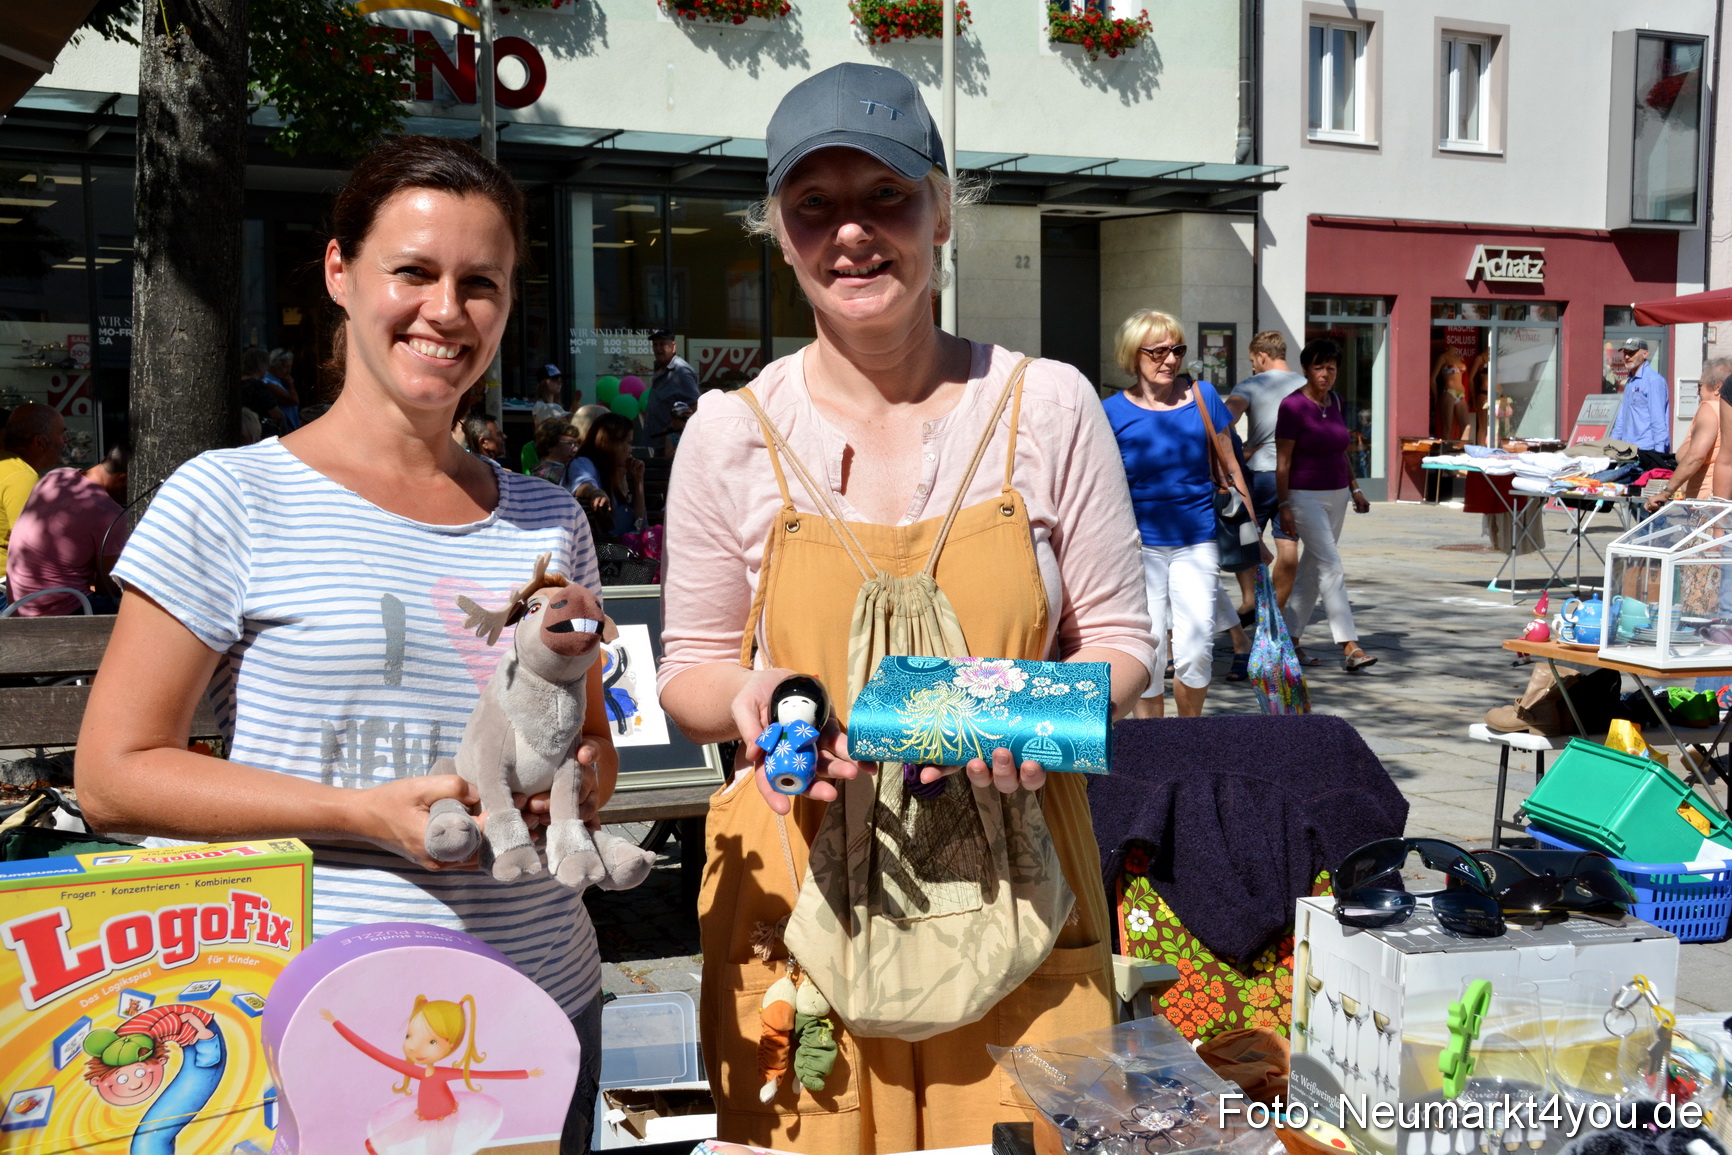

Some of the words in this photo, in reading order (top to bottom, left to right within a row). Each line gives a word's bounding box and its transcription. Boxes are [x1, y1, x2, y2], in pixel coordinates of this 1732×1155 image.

[1015, 254, 1031, 269] 22
[1465, 244, 1545, 282] Achatz
[99, 316, 121, 327] WIR
[99, 328, 132, 337] MO-FR
[570, 328, 588, 337] WIR
[591, 328, 612, 337] SIND
[615, 327, 633, 337] FÜR
[99, 337, 113, 345] SA
[603, 339, 621, 347] 9.00
[628, 339, 649, 347] 19.00
[1446, 335, 1476, 345] SCHLUSS
[603, 347, 621, 355] 9.00
[320, 717, 441, 789] NEW
[61, 890, 96, 900] Fragen
[112, 882, 180, 895] Konzentrieren
[195, 877, 252, 887] Kombinieren
[340, 930, 409, 946] PUZZLE
[370, 934, 411, 942] studio
[8, 891, 292, 1004] LogoFix
[207, 955, 225, 965] für
[228, 954, 260, 966] Kinder
[79, 993, 100, 1008] Das
[101, 968, 152, 996] Logikspiel
[1290, 1070, 1299, 1082] 6x
